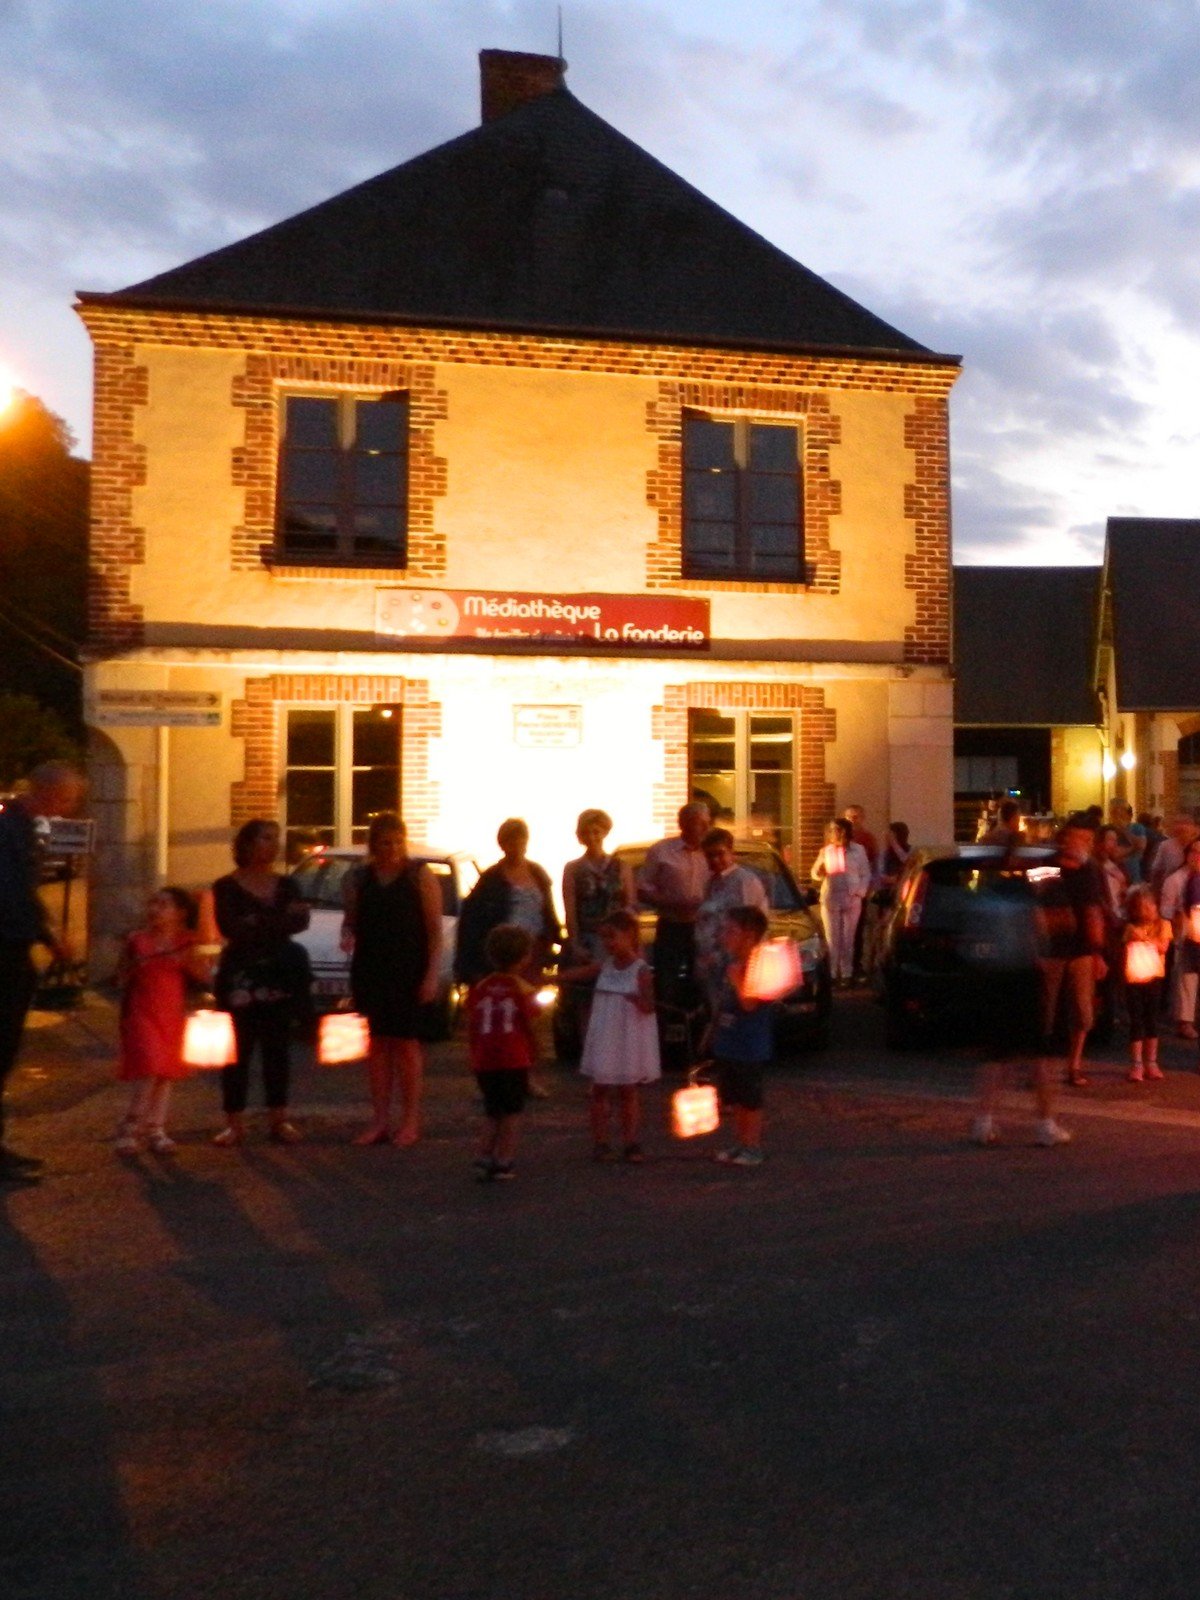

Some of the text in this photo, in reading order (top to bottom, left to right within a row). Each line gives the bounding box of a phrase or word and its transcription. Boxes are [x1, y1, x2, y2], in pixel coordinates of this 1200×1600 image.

[464, 596, 601, 624] Médiathèque
[594, 622, 619, 642] La
[477, 996, 517, 1034] 11
